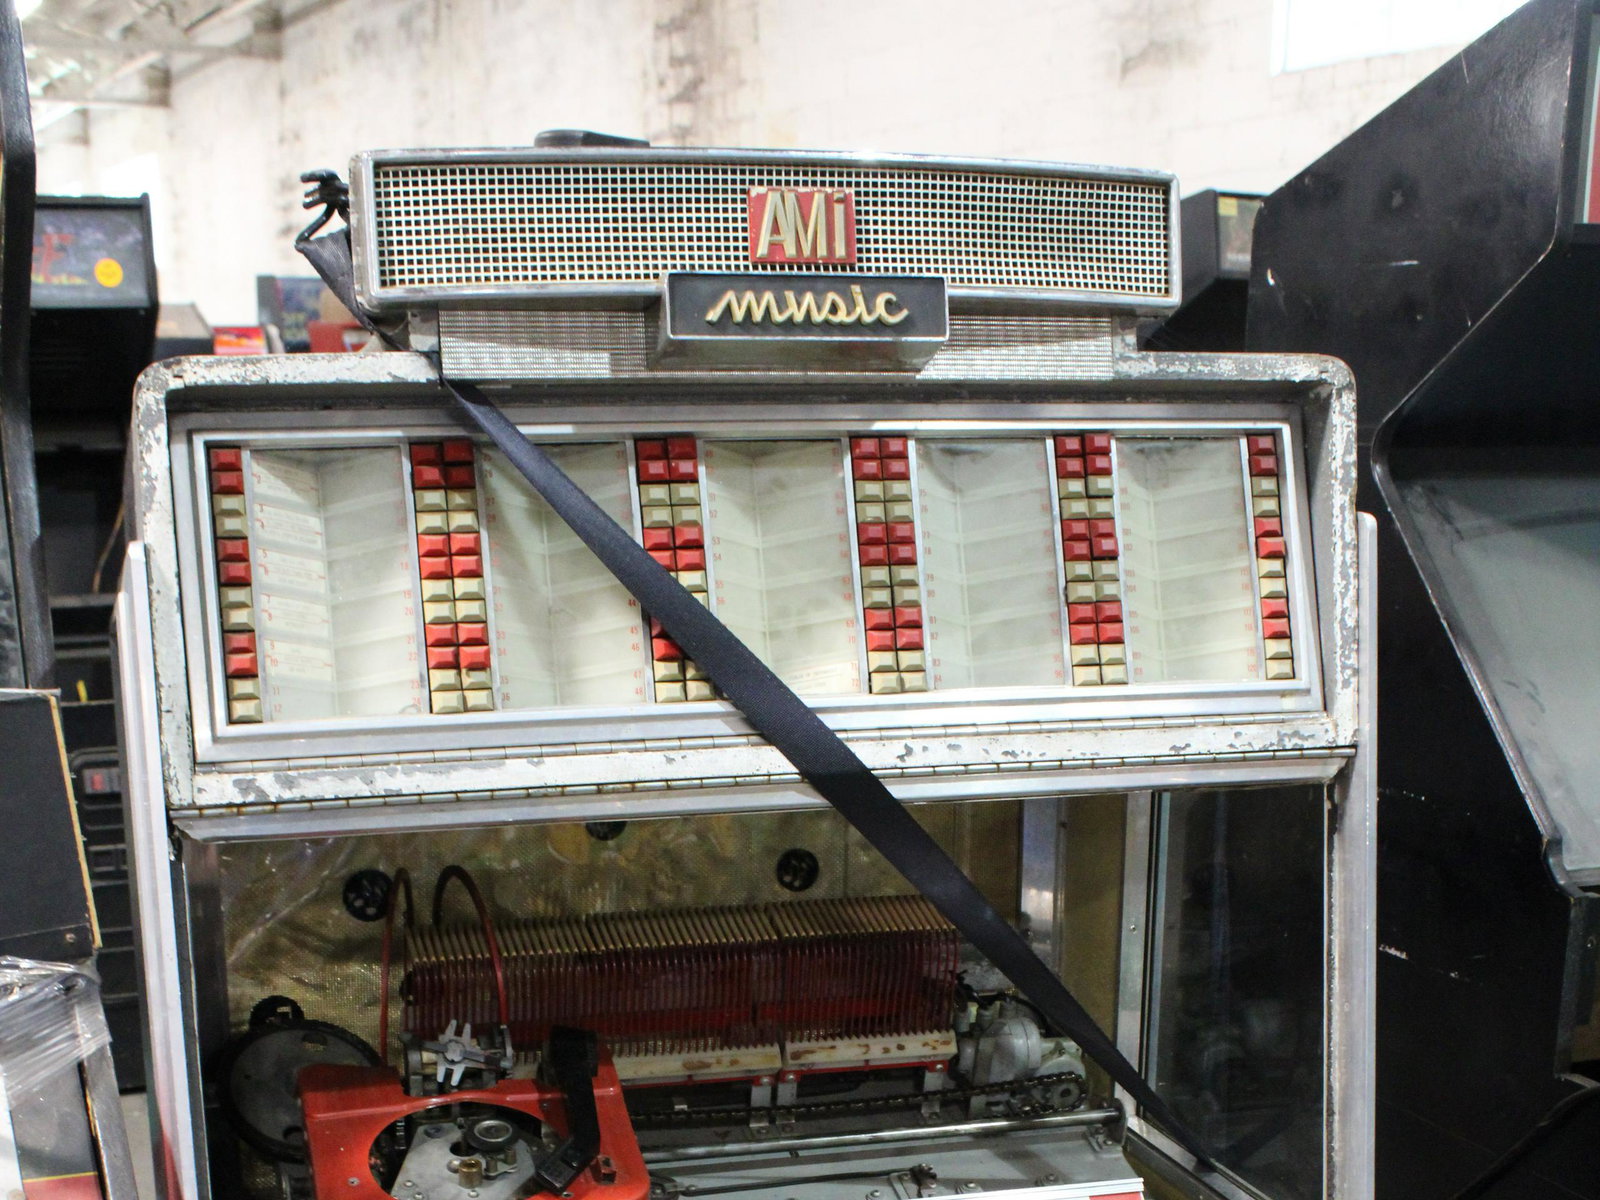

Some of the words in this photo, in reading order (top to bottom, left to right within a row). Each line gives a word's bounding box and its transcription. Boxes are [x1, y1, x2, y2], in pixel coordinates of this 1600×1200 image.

[705, 284, 909, 326] music
[712, 536, 720, 545] 53
[713, 552, 722, 561] 54
[403, 590, 411, 599] 19
[628, 599, 636, 607] 44
[404, 607, 414, 616] 20
[630, 626, 638, 635] 45
[631, 643, 640, 652] 46
[408, 652, 417, 661] 22
[850, 662, 858, 671] 71
[633, 670, 641, 679] 47
[411, 680, 420, 689] 23
[852, 678, 859, 687] 72
[273, 687, 280, 696] 11
[635, 687, 643, 696] 48
[501, 692, 510, 702] 36
[274, 703, 282, 713] 12
